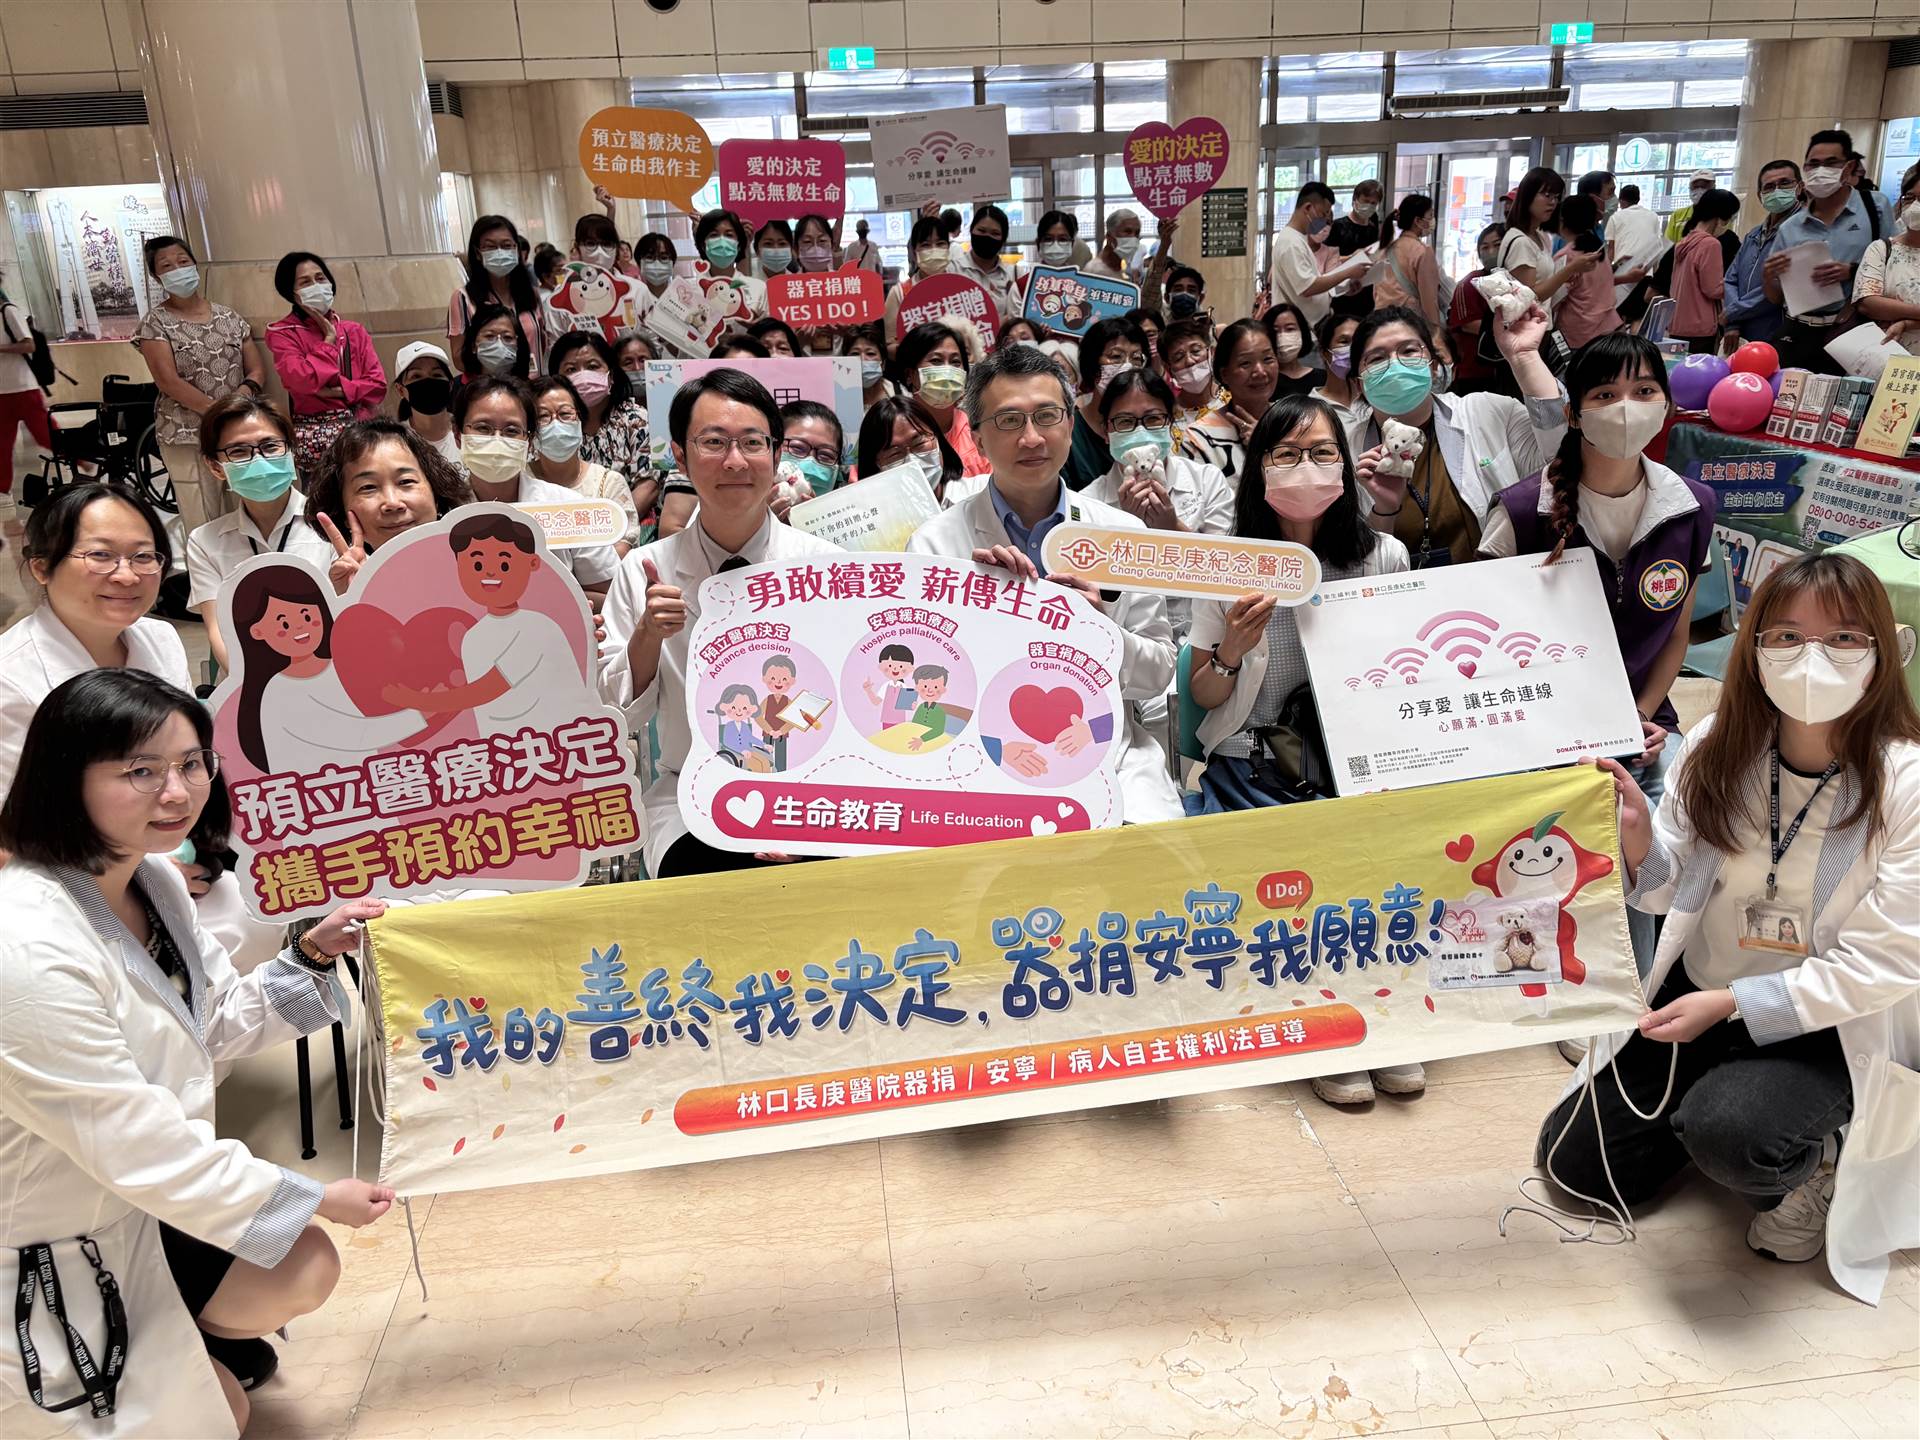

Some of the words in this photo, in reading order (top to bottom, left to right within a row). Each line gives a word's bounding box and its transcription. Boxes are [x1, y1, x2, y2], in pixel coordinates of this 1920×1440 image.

[591, 128, 702, 154] 預立醫療決定
[1128, 131, 1224, 166] 愛的決定
[592, 153, 702, 179] 生命由我作主
[746, 156, 822, 177] 愛的決定
[1133, 162, 1213, 187] 點亮無數
[728, 181, 841, 203] 點亮無數生命
[1148, 186, 1187, 210] 生命
[787, 276, 861, 299] 器官捐贈
[1088, 286, 1135, 308] 感謝長庚
[778, 304, 811, 321] YES
[816, 304, 822, 320] I
[902, 286, 987, 332] 器官捐贈
[1701, 461, 1776, 481] 預立醫療決定
[1724, 491, 1785, 508] 生命由你做主
[534, 509, 611, 528] 紀念醫院
[1111, 538, 1303, 580] 林口長庚紀念醫院
[1110, 564, 1143, 578] Chang
[1147, 567, 1173, 581] Gung
[1177, 570, 1222, 584] Memorial
[1225, 575, 1269, 590] Hospital,
[1270, 579, 1302, 592] Linkou
[1651, 578, 1677, 594] 桃園
[745, 562, 906, 613] 勇敢續愛
[921, 566, 1076, 632] 薪傳生命
[868, 607, 958, 638] 安寧緩和療護
[700, 622, 791, 664] 預立醫療決定
[860, 630, 897, 655] Hospice
[899, 627, 943, 644] palliative
[942, 642, 961, 661] care
[709, 648, 746, 679] Advance
[748, 642, 791, 654] decision
[1029, 642, 1113, 688] 器官捐贈意願
[1030, 661, 1061, 671] Organ
[1063, 665, 1098, 697] donation
[1398, 695, 1453, 720] 分享愛
[1463, 683, 1554, 711] 讓生命連線
[234, 719, 622, 842] 預立醫療決定
[772, 795, 904, 832] 生命教育
[910, 809, 940, 825] Life
[944, 811, 1023, 829] Education
[256, 787, 638, 912] 攜手預約幸福
[1266, 884, 1271, 899] I
[1275, 880, 1302, 899] Do!
[737, 1065, 956, 1119] 林口長庚醫院器捐
[986, 1056, 1039, 1084] 安寧
[1068, 1017, 1307, 1073] 病人自主權利法宣導
[37, 1247, 50, 1263] JULY
[41, 1263, 54, 1283] 2023
[45, 1283, 55, 1306] ARENA
[24, 1351, 37, 1368] LIVE
[75, 1345, 89, 1365] 2023
[81, 1363, 96, 1380] JULY
